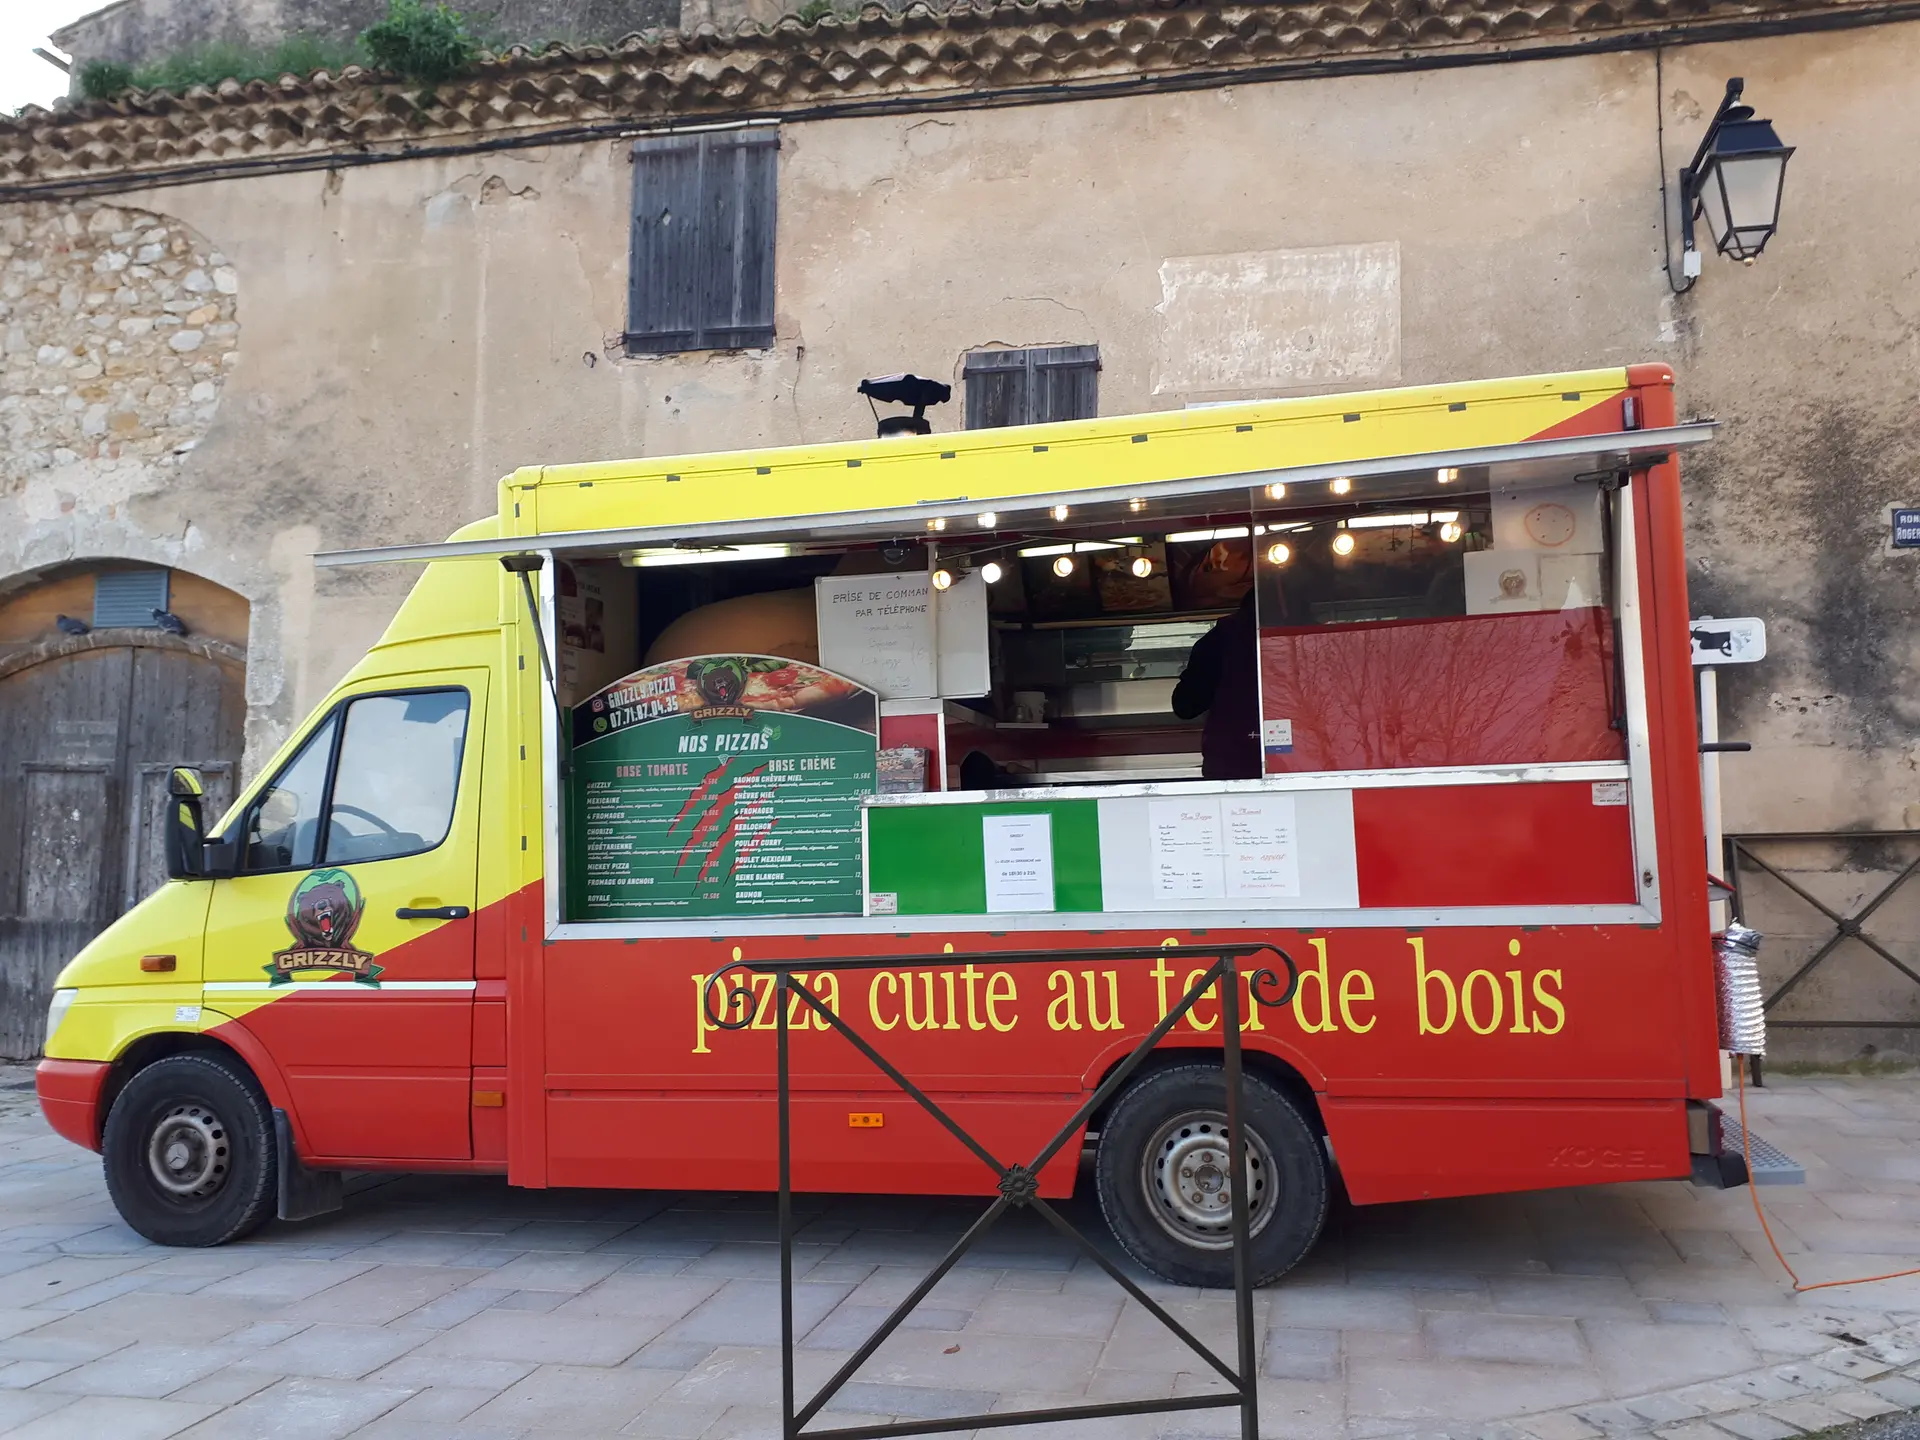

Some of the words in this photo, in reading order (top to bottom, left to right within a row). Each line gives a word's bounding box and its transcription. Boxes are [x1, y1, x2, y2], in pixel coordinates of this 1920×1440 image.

[868, 591, 882, 601] DE
[885, 587, 948, 601] COMMAN
[855, 609, 873, 618] PAR
[693, 707, 751, 719] GRIZZLY
[678, 735, 708, 753] NOS
[715, 733, 769, 752] PIZZAS
[647, 763, 688, 777] TOMATE
[768, 759, 795, 772] BASE
[787, 774, 803, 782] MIEL
[735, 839, 760, 847] POULET
[735, 856, 760, 864] POULET
[612, 862, 630, 870] PIZZA
[587, 878, 616, 886] FROMAGE
[587, 894, 611, 902] ROYALE
[278, 951, 368, 970] GRIZZLY
[690, 945, 840, 1054] pizza
[868, 942, 1019, 1033] cuite
[1046, 969, 1125, 1032] au
[1291, 937, 1377, 1035] de
[1406, 937, 1566, 1036] bois
